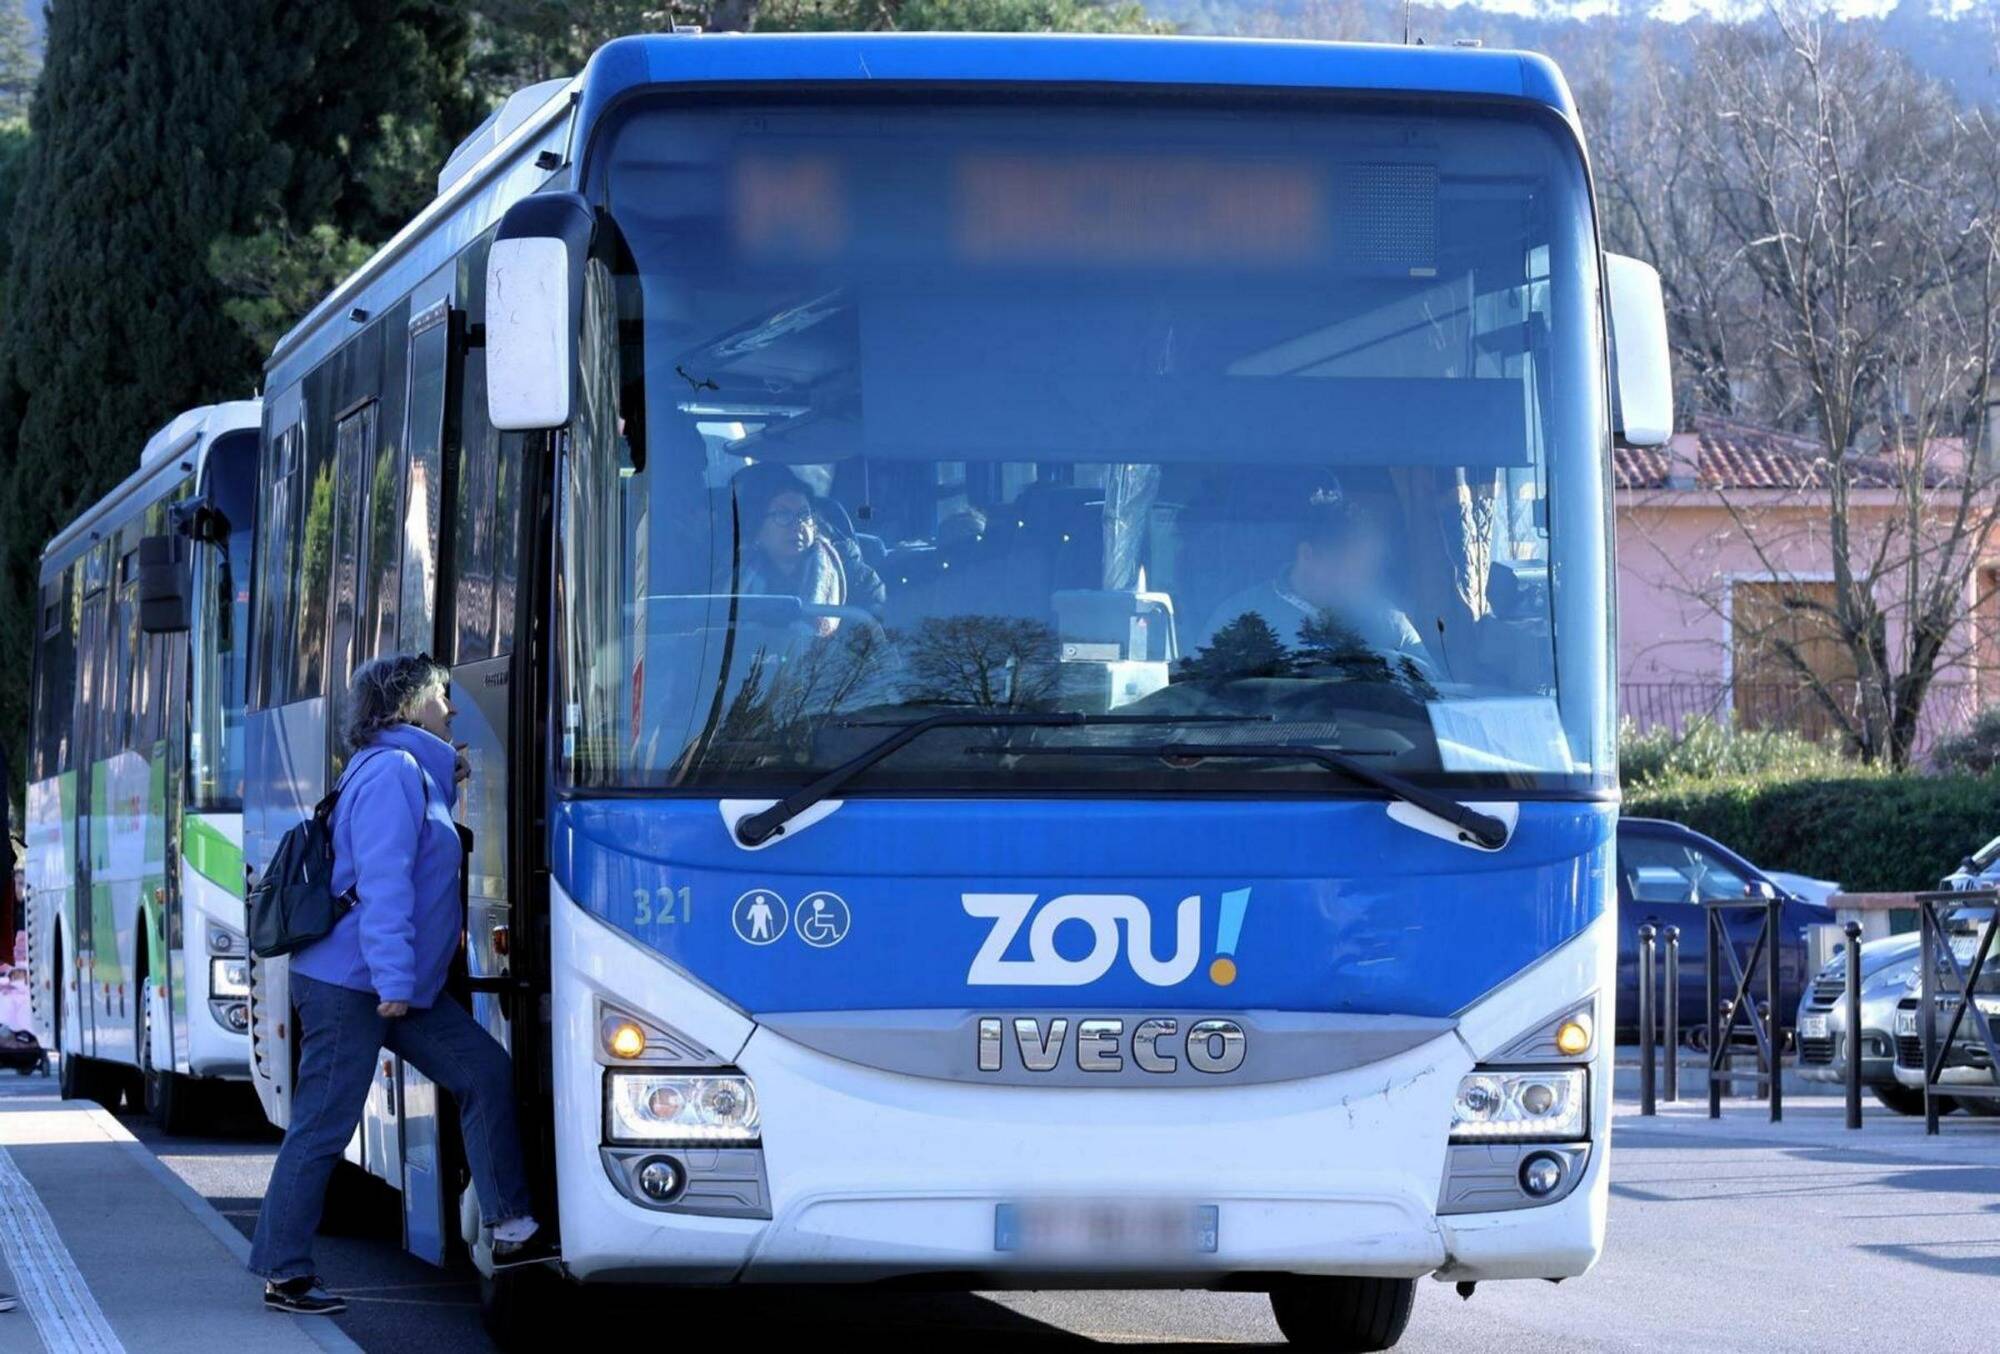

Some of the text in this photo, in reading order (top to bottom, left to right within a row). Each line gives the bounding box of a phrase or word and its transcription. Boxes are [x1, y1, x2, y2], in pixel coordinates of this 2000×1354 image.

[633, 886, 691, 926] 321
[961, 886, 1253, 988] ZOU!
[977, 1017, 1247, 1075] IVECO
